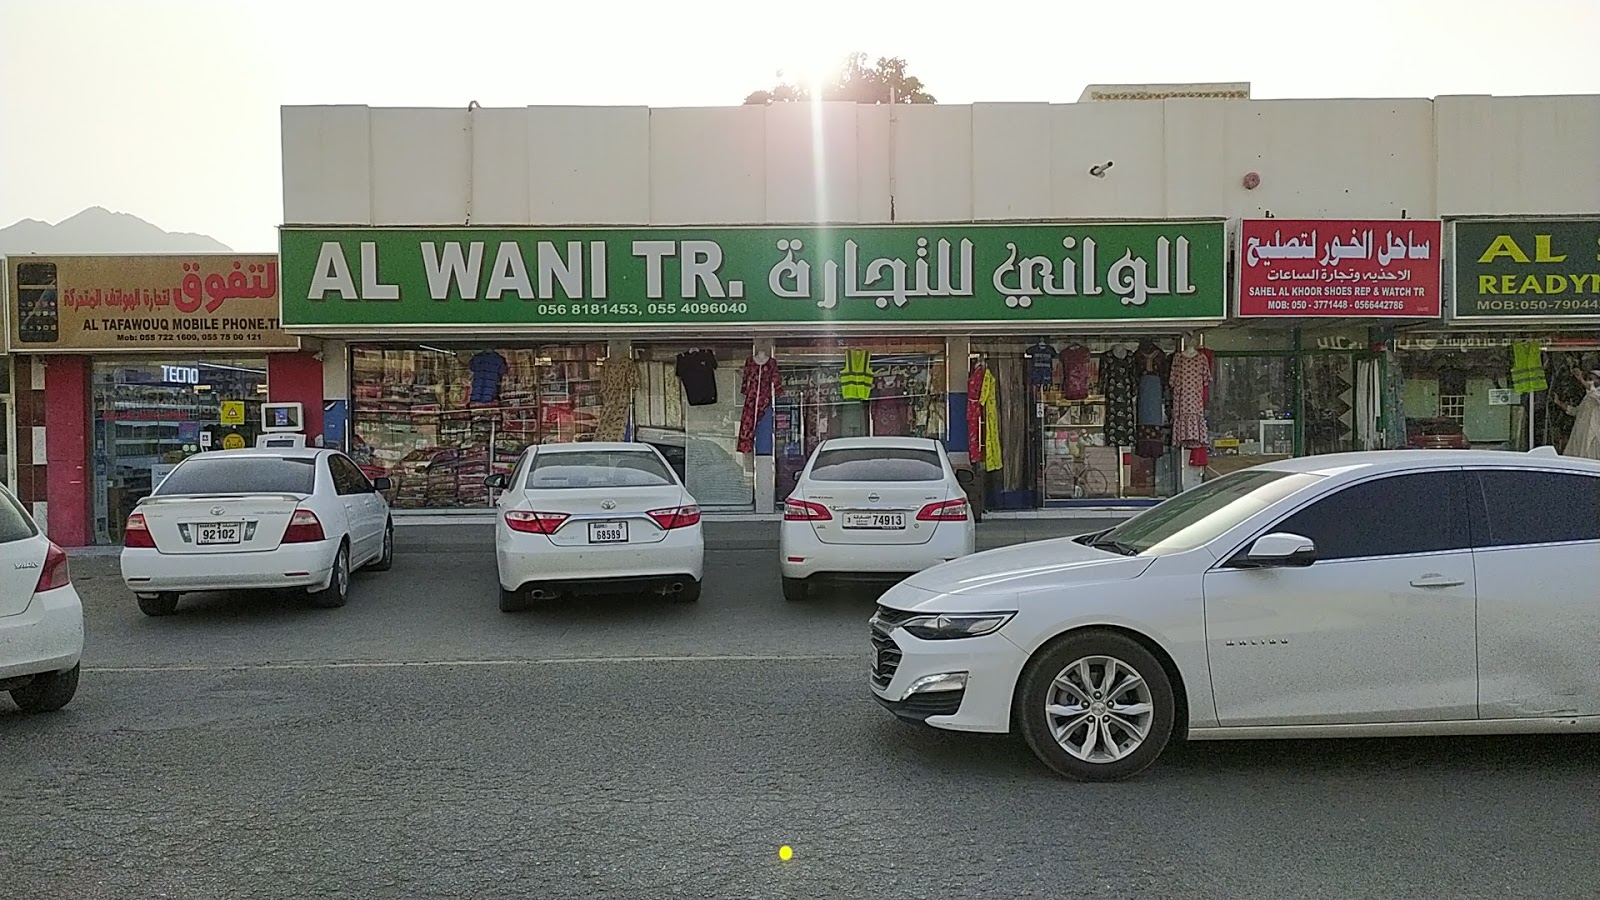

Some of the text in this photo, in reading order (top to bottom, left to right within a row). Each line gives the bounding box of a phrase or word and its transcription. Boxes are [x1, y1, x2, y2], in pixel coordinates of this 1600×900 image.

[1246, 228, 1430, 267] ساحل الخور لتصليح
[1477, 234, 1568, 263] AL
[307, 240, 744, 300] AL WANI TR.
[768, 236, 975, 309] للتجارة
[1267, 268, 1319, 281] الساعات
[1321, 268, 1361, 283] وتجارة
[1249, 286, 1425, 297] SAHEL AL KHOOR SHOES REP & WATCH TR
[537, 302, 748, 316] 056 8181453, 055 4096040
[1267, 300, 1290, 310] MOB:
[1291, 300, 1307, 310] 050
[1313, 300, 1348, 310] 3771448
[1354, 300, 1404, 310] 0566442786
[1477, 300, 1600, 311] MOB:050-79044
[82, 318, 99, 331] AL
[101, 318, 169, 331] TAFAWOUQ
[172, 318, 219, 330] MOBILE
[139, 333, 156, 341] 055
[158, 333, 174, 341] 722
[201, 333, 218, 341] 055
[219, 333, 231, 341] 75
[233, 333, 244, 341] 00
[246, 333, 262, 341] 121
[161, 365, 199, 384] TECNO
[873, 515, 902, 526] 74913
[203, 529, 235, 540] 92102
[597, 531, 621, 540] 68589
